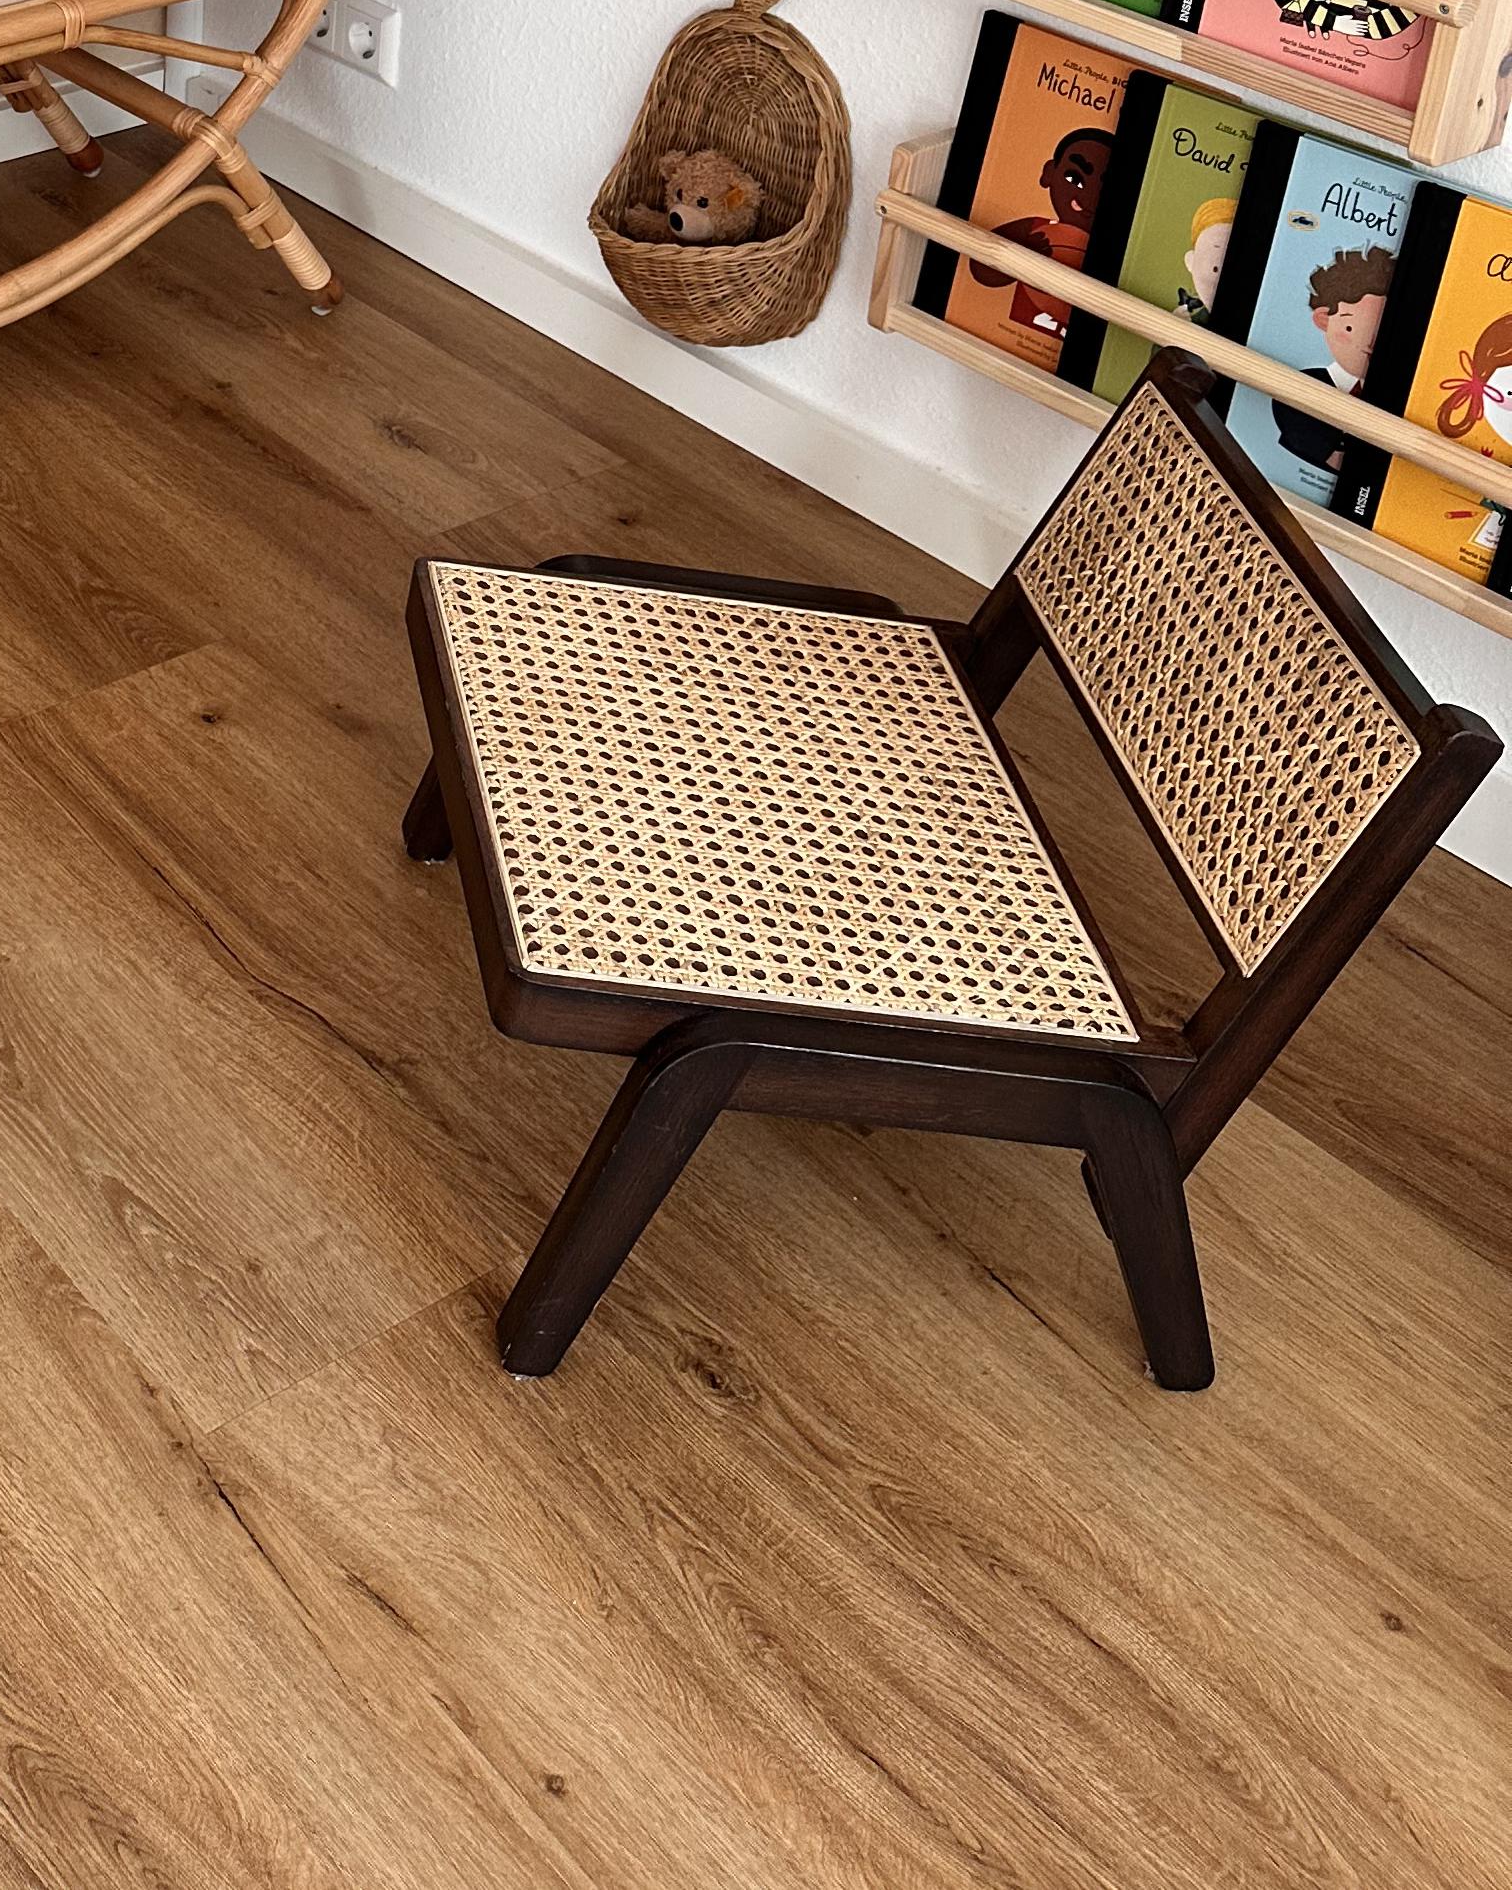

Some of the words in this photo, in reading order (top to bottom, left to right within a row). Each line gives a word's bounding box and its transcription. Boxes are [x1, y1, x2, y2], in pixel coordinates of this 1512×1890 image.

[1037, 62, 1117, 114] Michael
[1172, 127, 1236, 174] David
[1321, 182, 1398, 237] Albert
[1354, 486, 1371, 516] INSEL
